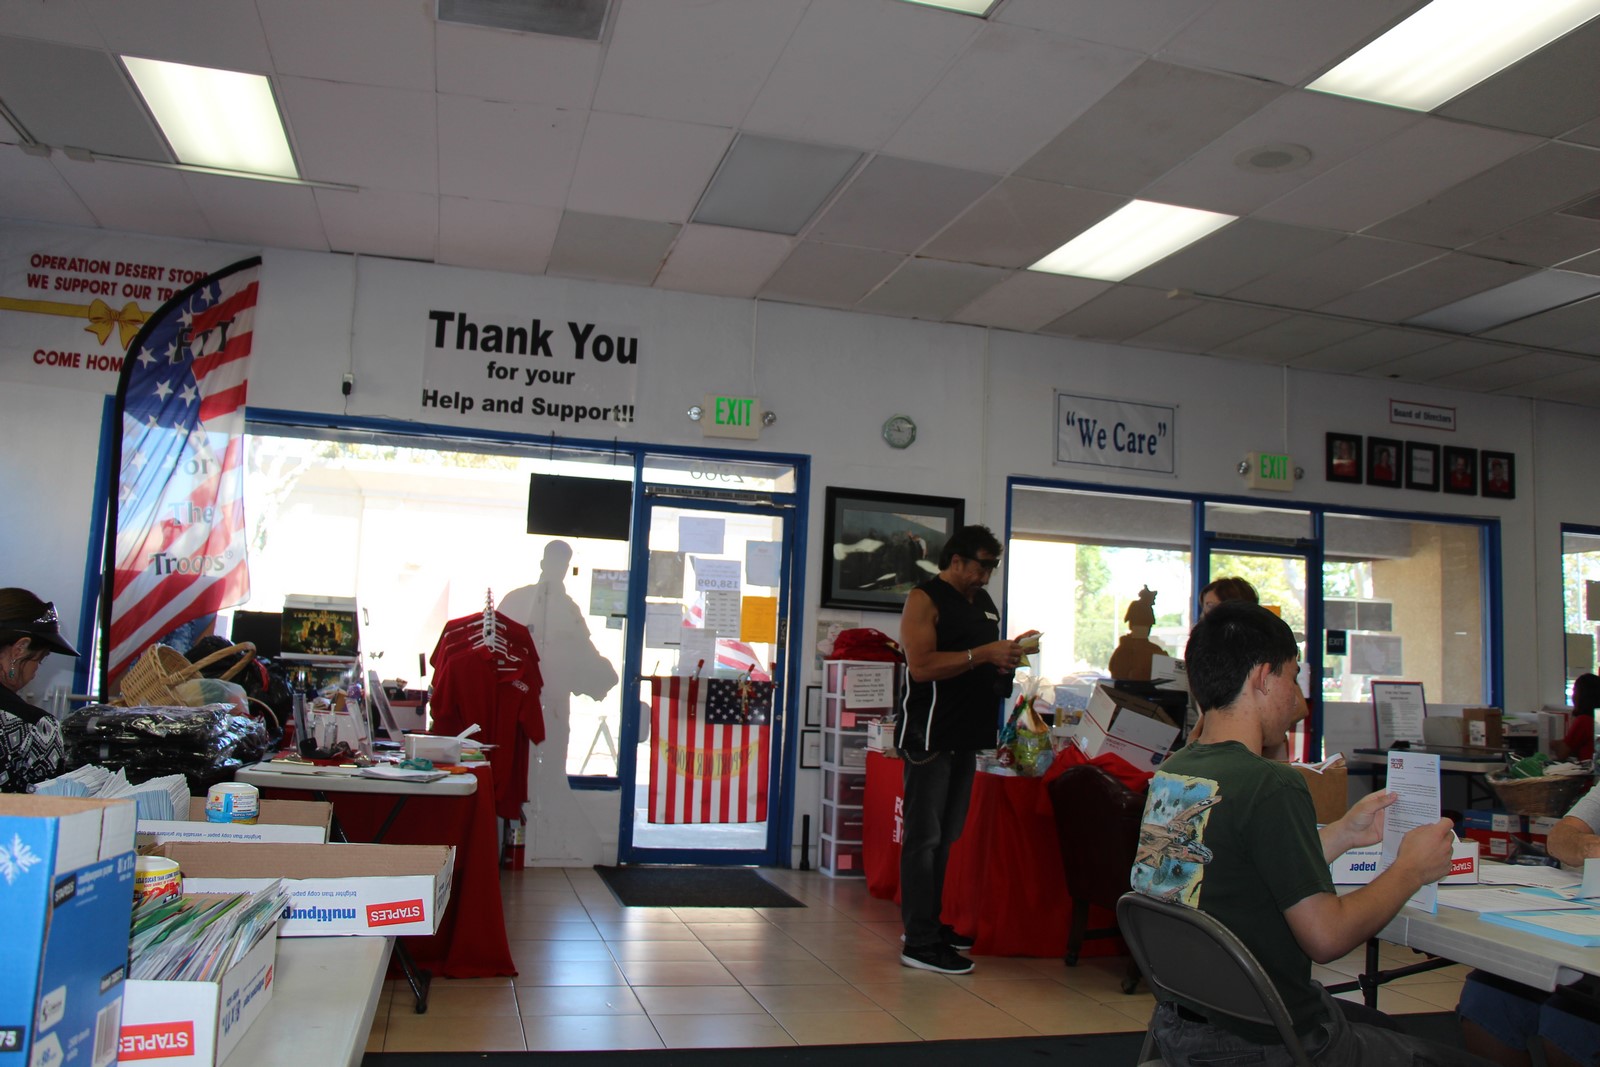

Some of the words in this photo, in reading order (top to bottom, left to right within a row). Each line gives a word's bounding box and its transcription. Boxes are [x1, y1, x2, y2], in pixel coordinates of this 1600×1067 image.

[30, 253, 111, 275] OPERATION
[115, 261, 165, 281] DESERT
[27, 273, 49, 289] WE
[54, 276, 118, 296] SUPPORT
[122, 283, 152, 300] OUR
[428, 309, 554, 357] Thank
[567, 321, 638, 364] You
[32, 349, 80, 369] COME
[486, 361, 519, 380] for
[525, 368, 576, 386] your
[422, 388, 474, 414] Help
[481, 396, 524, 414] and
[531, 398, 635, 423] Support!!
[715, 397, 754, 426] EXIT
[1393, 408, 1413, 418] Board
[1414, 411, 1421, 419] of
[1423, 412, 1452, 423] Directors
[1066, 411, 1107, 450] “We
[1113, 422, 1167, 456] Care”
[1260, 454, 1289, 480] EXIT
[168, 502, 214, 525] The
[1328, 636, 1345, 647] EXIT
[1350, 862, 1376, 872] paper
[0, 1030, 17, 1047] 75
